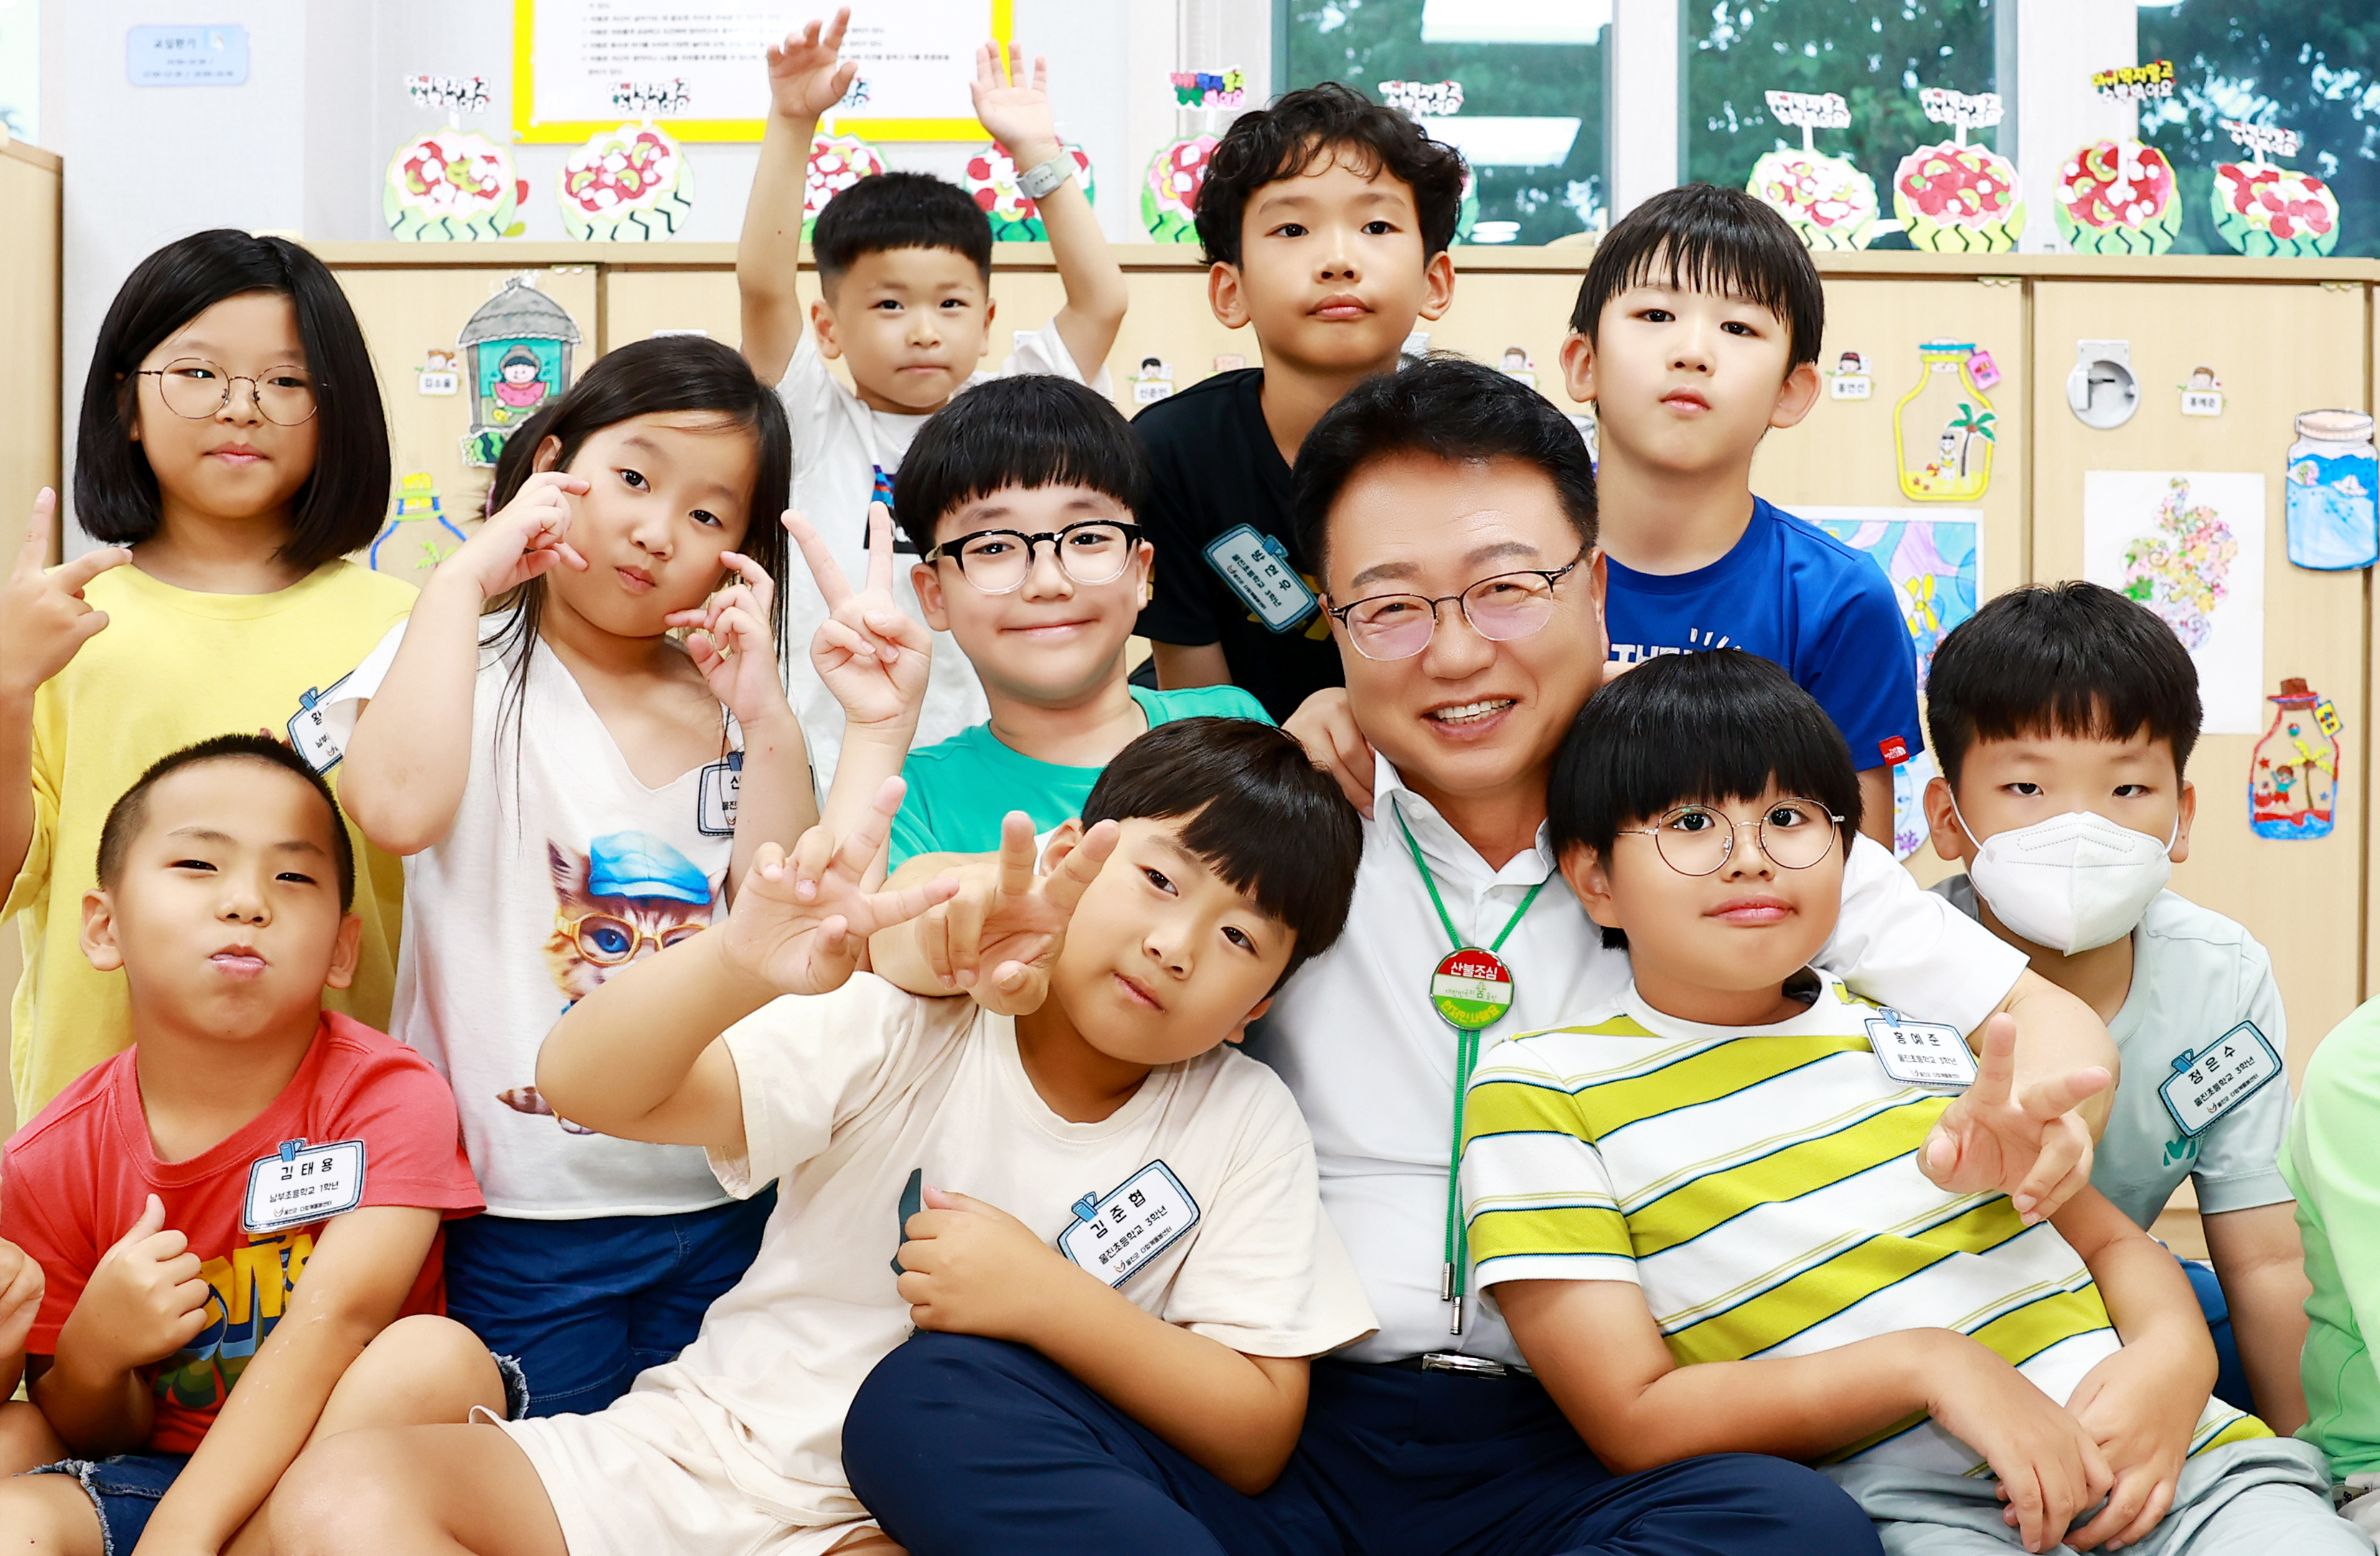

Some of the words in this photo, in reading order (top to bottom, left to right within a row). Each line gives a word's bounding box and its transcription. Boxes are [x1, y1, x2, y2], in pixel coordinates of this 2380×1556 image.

[1231, 554, 1265, 589] 울진초등학교
[1264, 590, 1282, 608] 3학년
[1450, 962, 1497, 981] 산불조심
[1939, 1057, 1958, 1065] 3학년
[2193, 1072, 2234, 1108] 울진초등학교
[2235, 1056, 2256, 1075] 3학년
[270, 1187, 315, 1203] 남부초등학교
[320, 1181, 339, 1192] 1학년
[1098, 1225, 1144, 1265] 울진초등학교
[1144, 1205, 1168, 1227] 3학년
